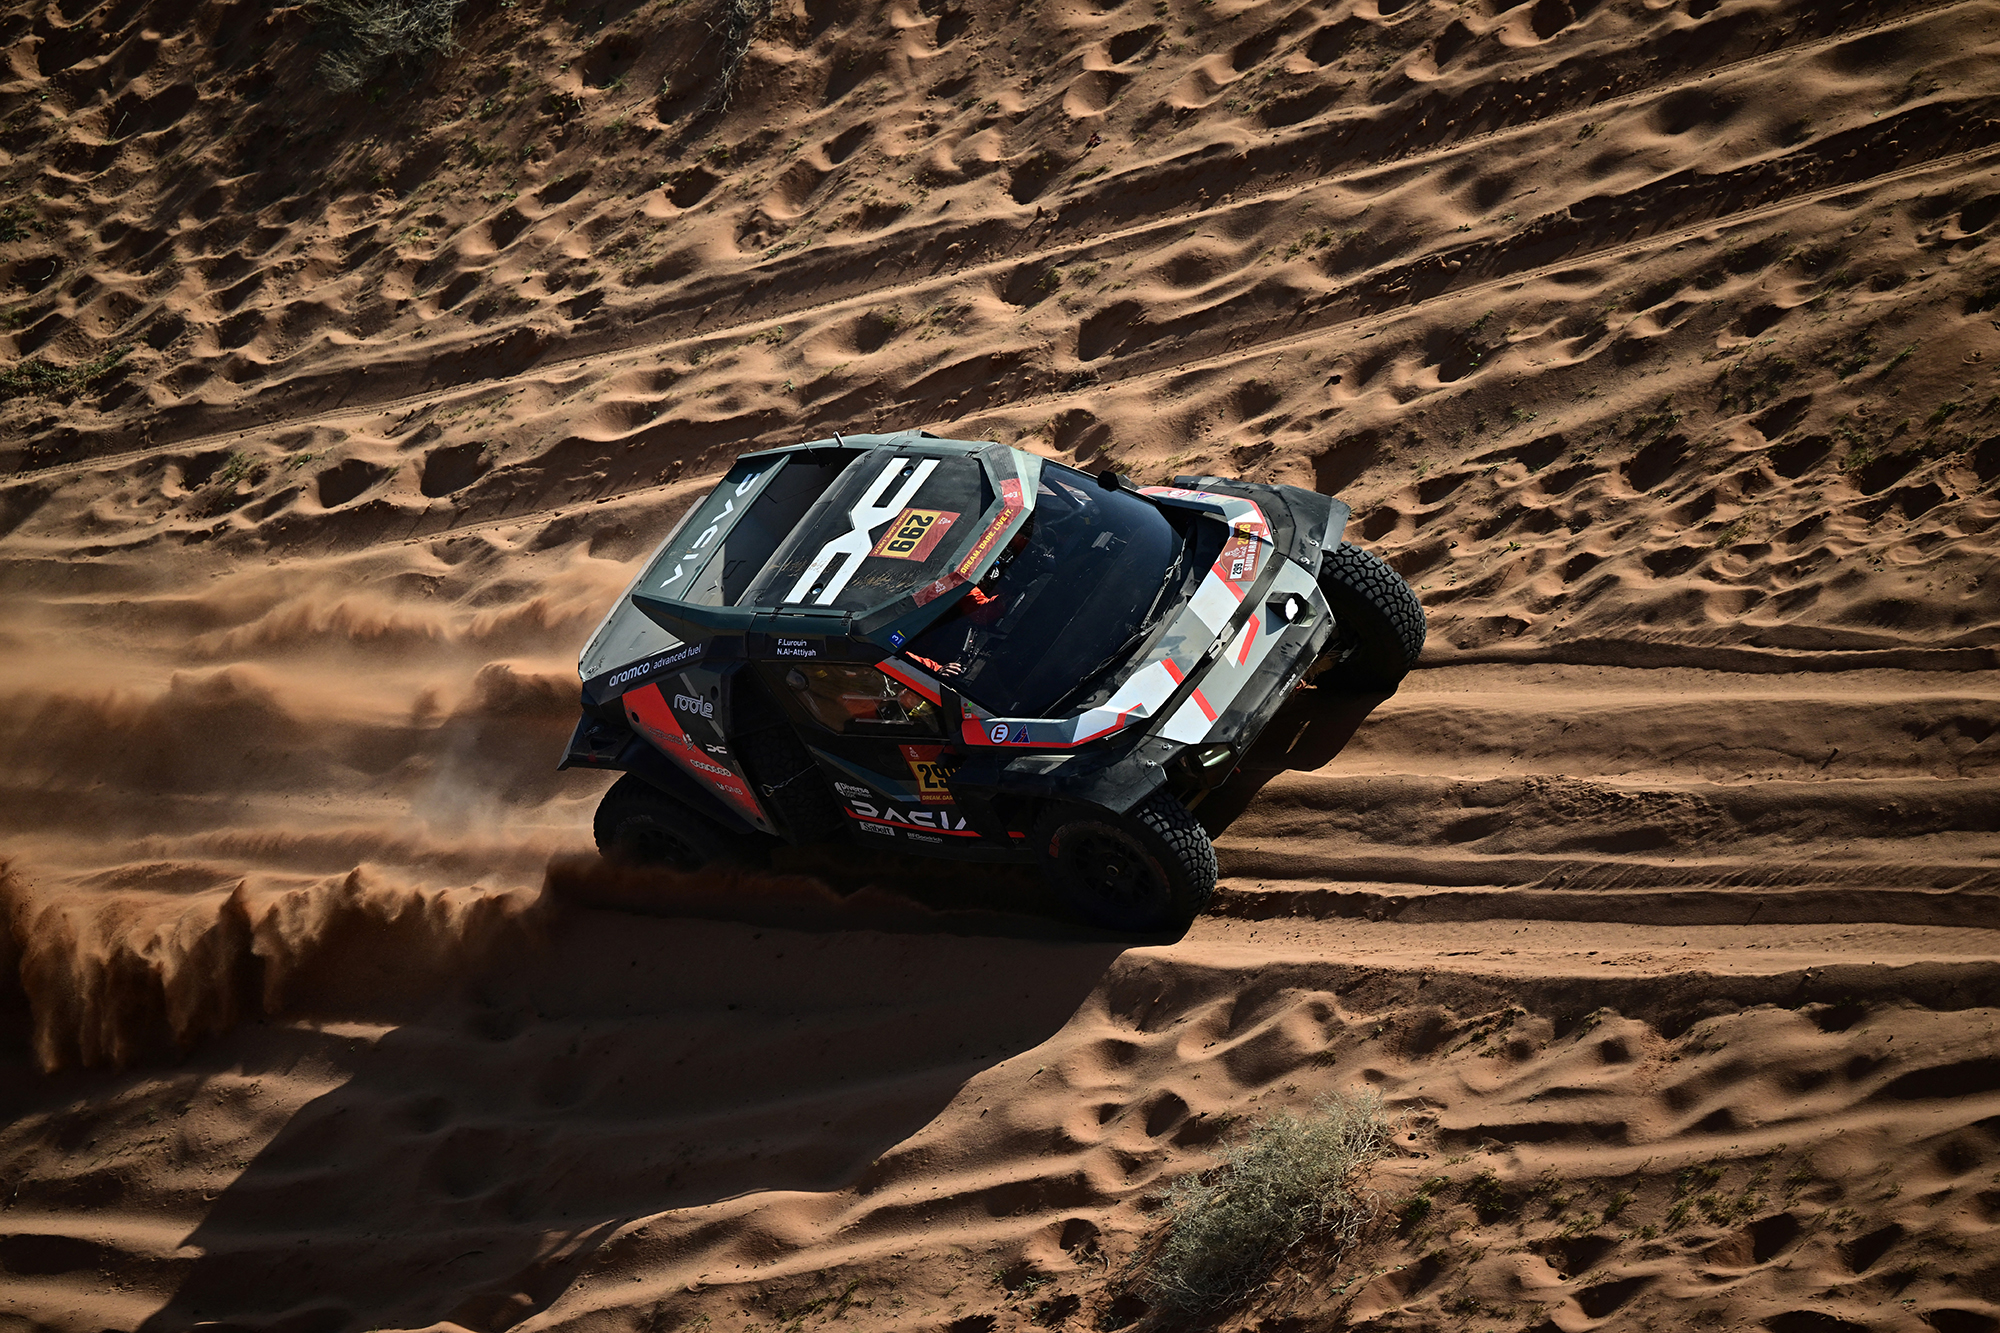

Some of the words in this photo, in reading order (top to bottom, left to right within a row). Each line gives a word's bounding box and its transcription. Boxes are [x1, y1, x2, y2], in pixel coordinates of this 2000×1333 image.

[887, 514, 934, 553] 299
[960, 547, 983, 575] DREAM.
[978, 528, 997, 550] DARE.
[993, 514, 1008, 531] LIVE
[1003, 506, 1014, 517] IT.
[1237, 523, 1251, 545] 2026
[1248, 530, 1259, 554] ARABIA
[1233, 562, 1243, 575] 299
[1244, 554, 1254, 571] SAUDI
[891, 634, 900, 642] 3
[776, 648, 817, 657] N.Al-Attiyah
[608, 662, 650, 687] aramco
[653, 649, 687, 670] advanced
[687, 644, 702, 659] fuel
[993, 727, 1006, 740] E
[917, 764, 955, 789] 29
